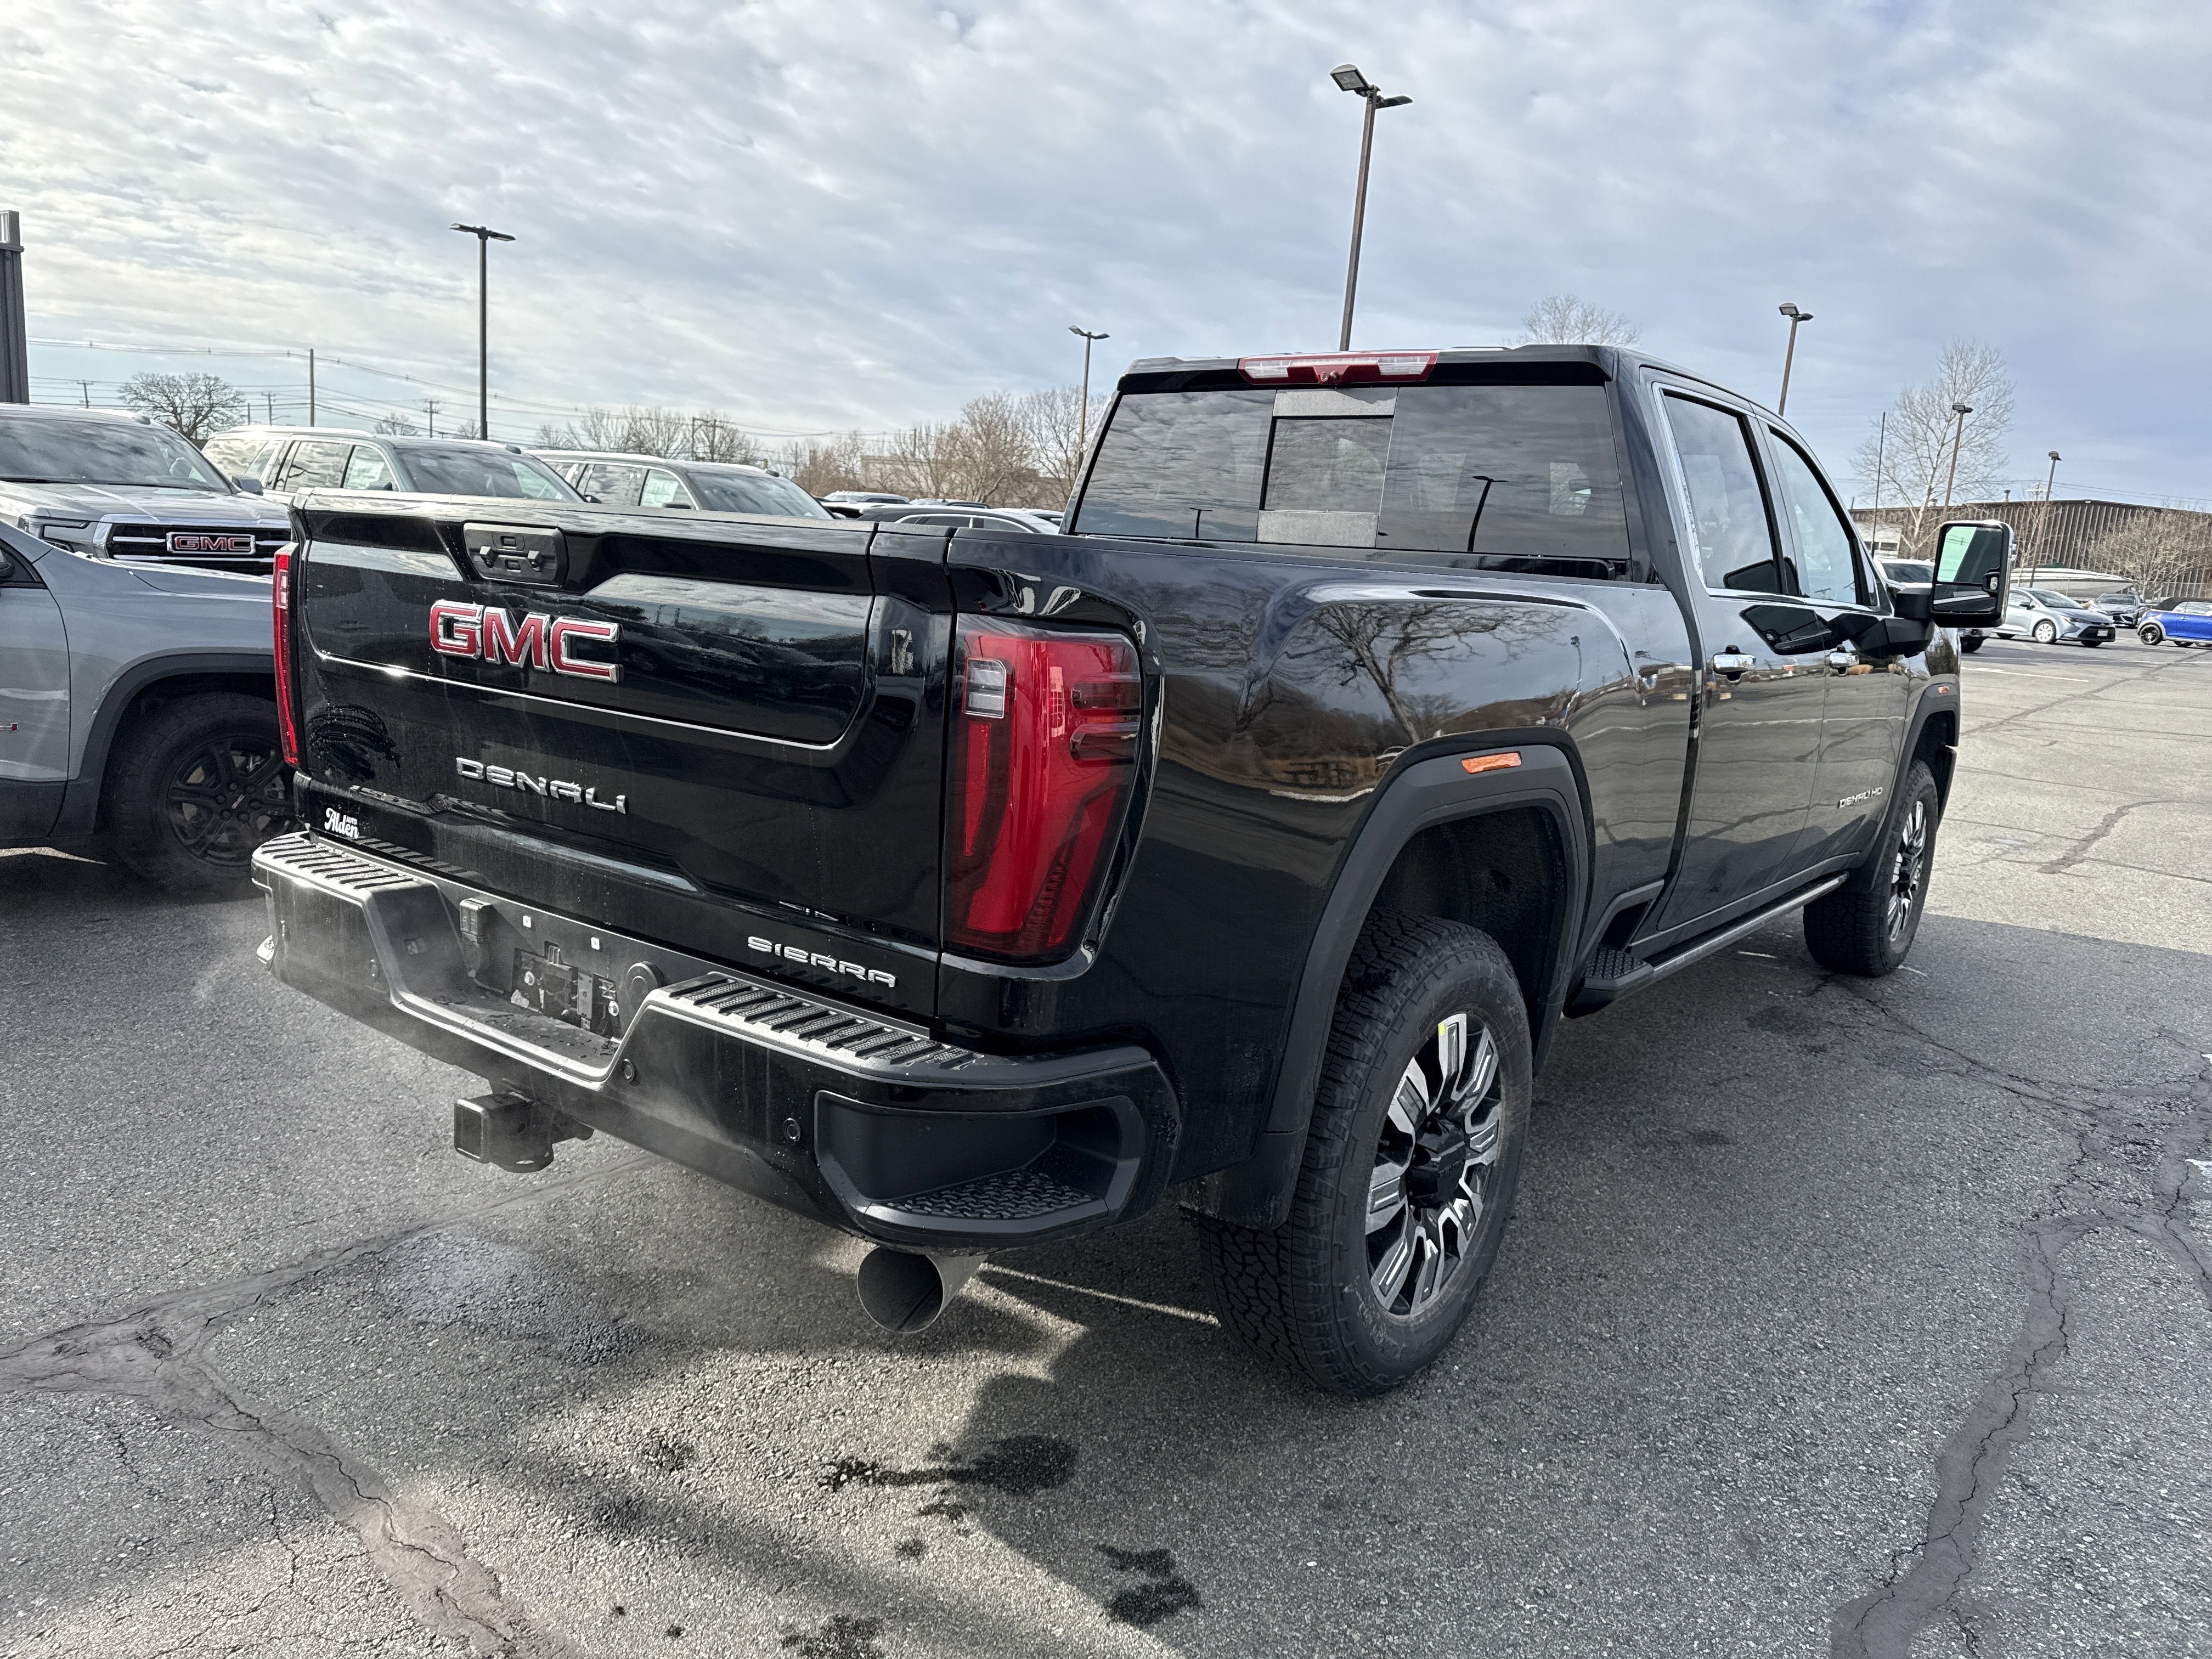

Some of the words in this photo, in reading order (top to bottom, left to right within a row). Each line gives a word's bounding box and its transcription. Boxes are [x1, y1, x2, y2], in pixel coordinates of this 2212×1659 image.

[174, 535, 251, 551] GMC
[430, 599, 623, 684] GMC
[456, 757, 627, 815] DENALI
[1838, 789, 1871, 809] DENALI
[1871, 786, 1883, 798] HD
[324, 808, 360, 839] Alden
[346, 816, 358, 825] AUTO
[748, 936, 896, 988] SIERRA
